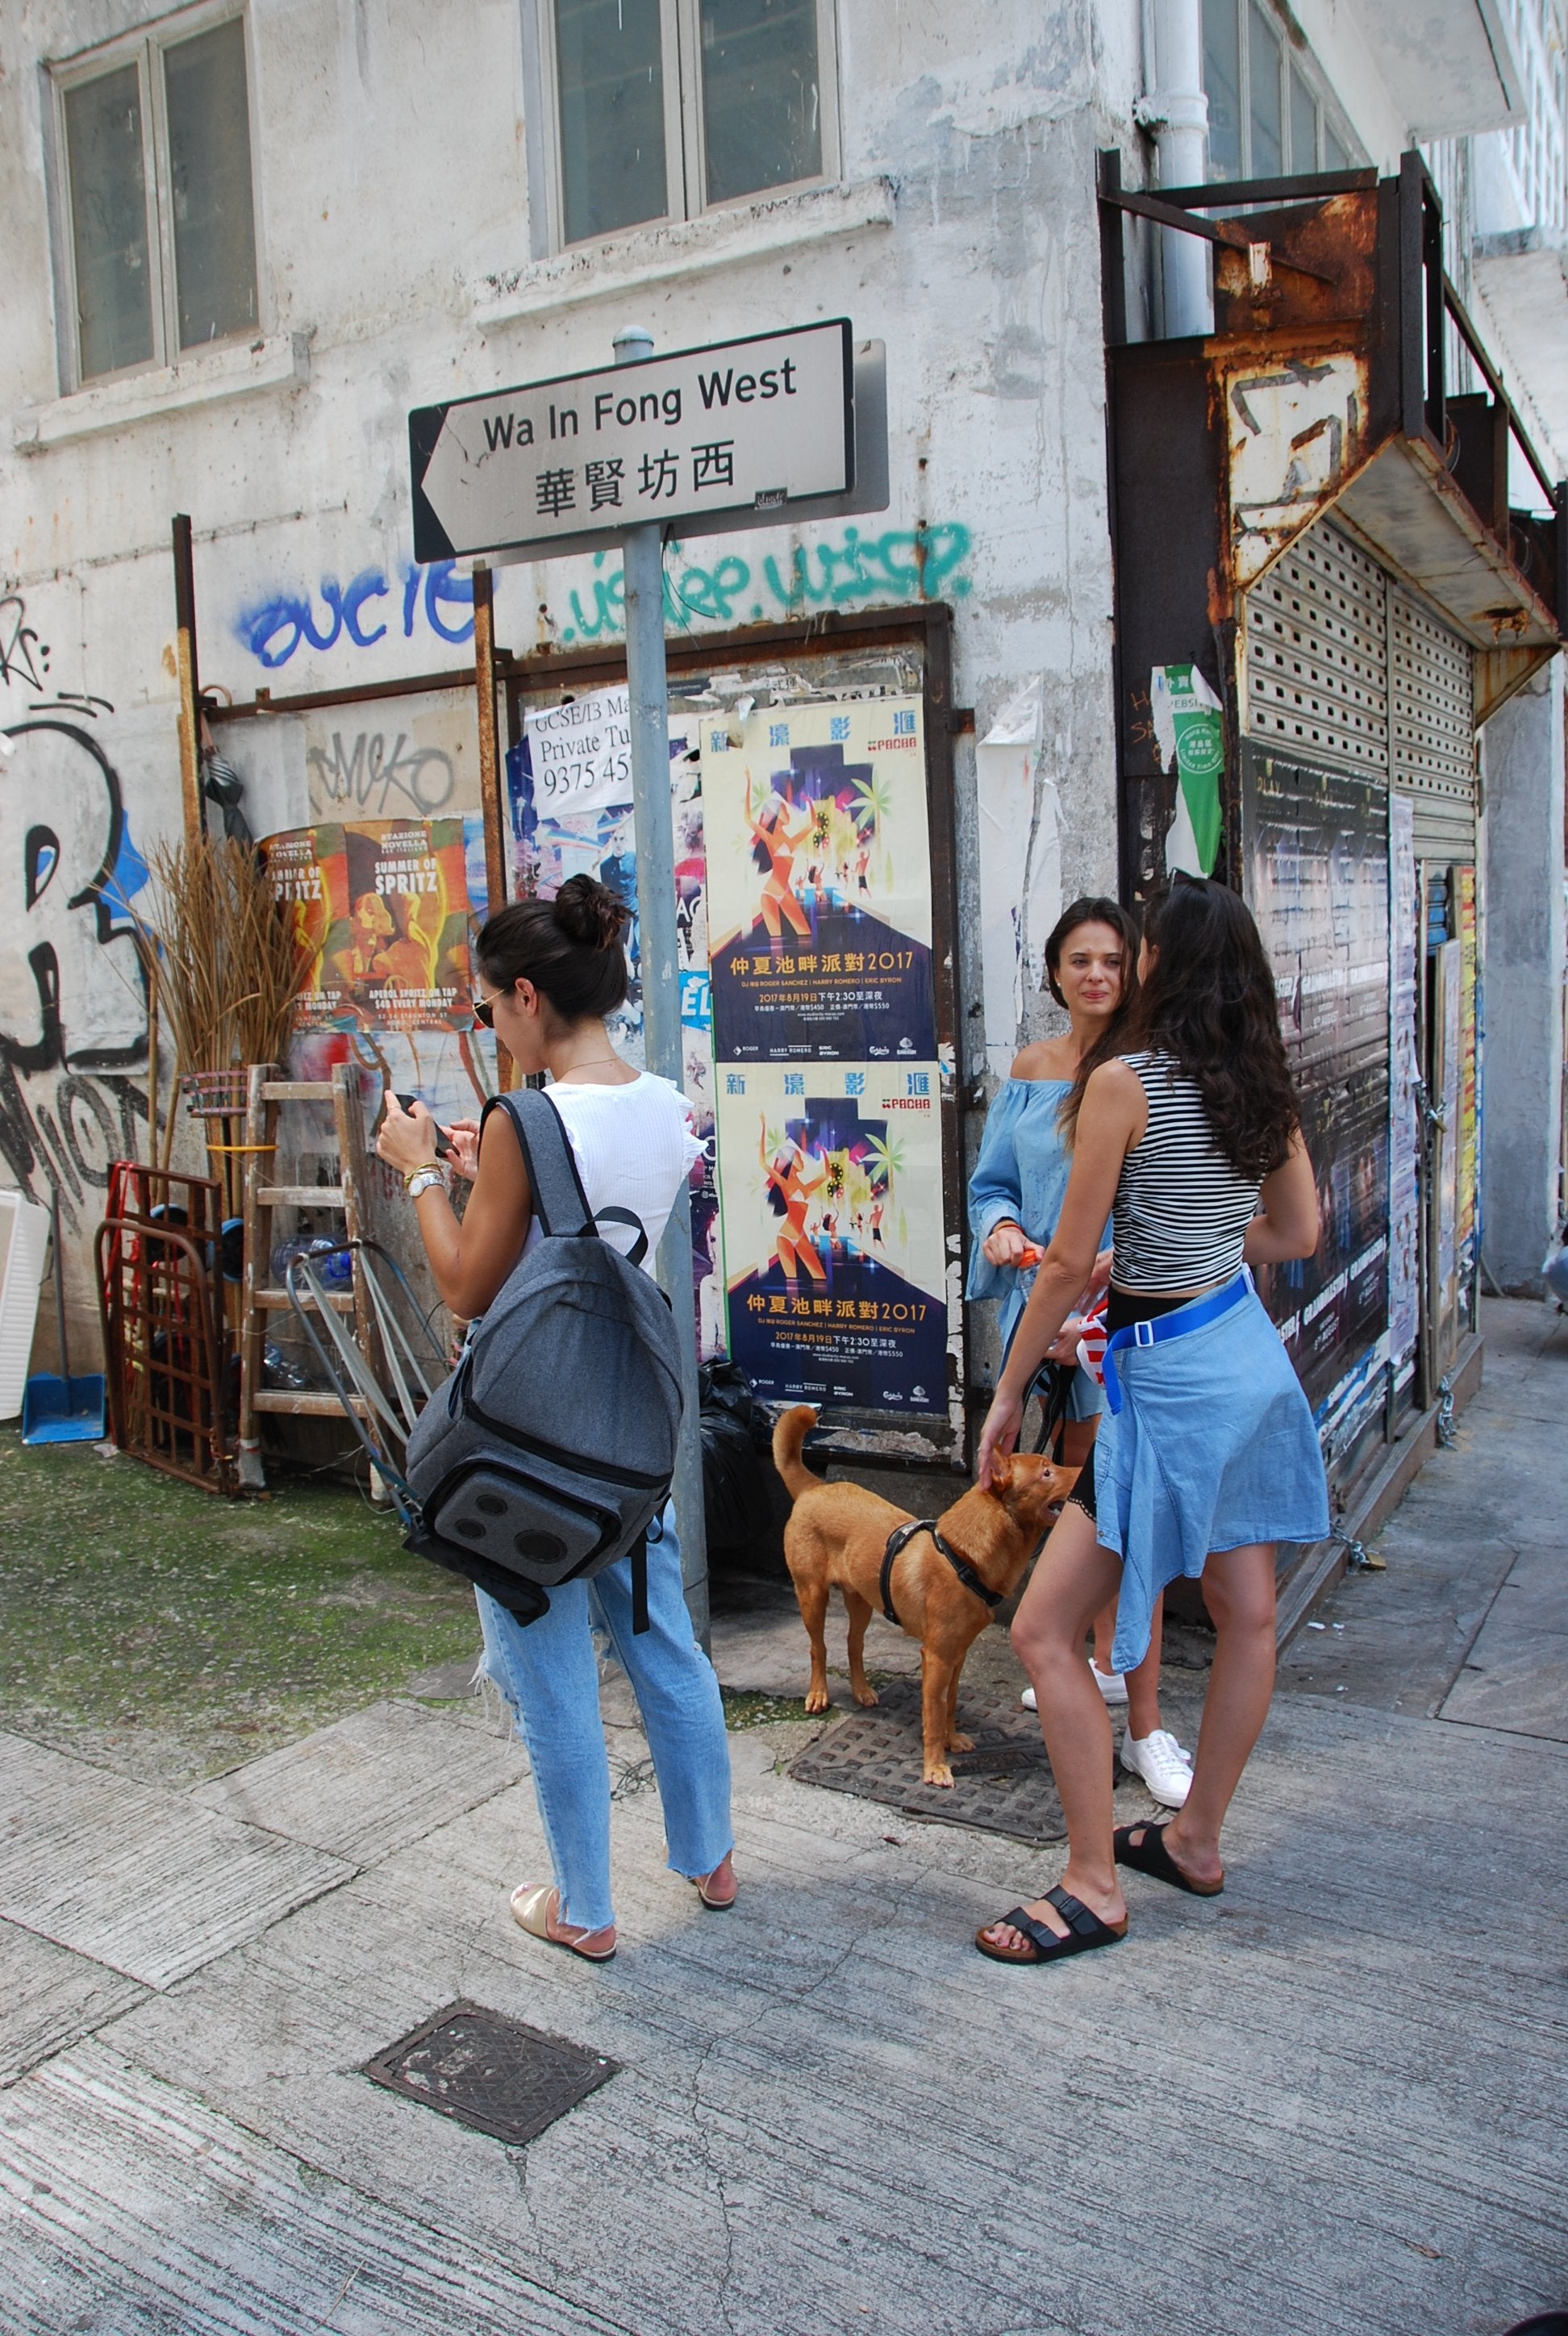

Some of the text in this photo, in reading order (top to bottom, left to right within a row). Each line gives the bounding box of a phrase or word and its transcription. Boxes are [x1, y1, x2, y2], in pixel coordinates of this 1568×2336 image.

[483, 357, 798, 452] Wa In Fong West
[536, 439, 735, 518] 華賢坊西
[540, 725, 632, 762] Private Tu
[544, 753, 633, 797] 9375 45
[381, 830, 427, 841] STAZIONE
[381, 839, 428, 850] NOVELLA
[308, 866, 321, 879] OF
[374, 857, 437, 874] SUMMER OF
[374, 871, 439, 896] SPRITZ
[730, 952, 914, 976] 仲夏池畔派對2017
[326, 991, 342, 1000] TAP
[369, 989, 398, 999] APEROL
[399, 988, 427, 999] SPRITZ
[442, 987, 457, 998] TAP
[305, 1000, 337, 1010] MONDAY
[392, 999, 416, 1008] EVERY
[419, 998, 452, 1008] MONDAY
[891, 1099, 931, 1109] PACHA
[747, 1294, 928, 1322] 仲夏池畔派對2017
